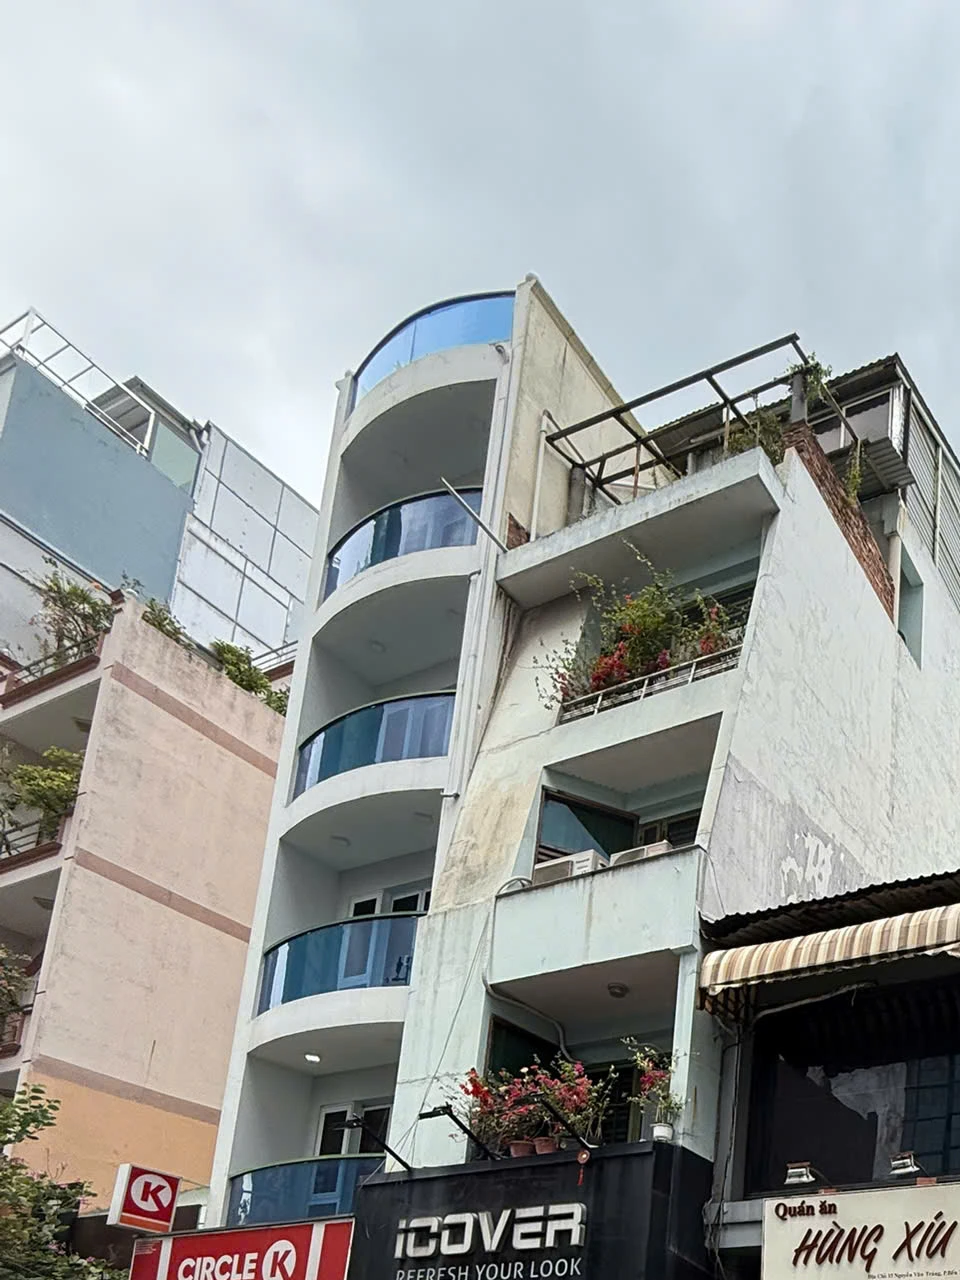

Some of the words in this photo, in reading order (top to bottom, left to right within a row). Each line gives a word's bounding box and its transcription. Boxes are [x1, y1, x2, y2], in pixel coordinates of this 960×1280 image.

[139, 1178, 168, 1212] K
[774, 1200, 815, 1221] Quán
[819, 1200, 838, 1217] ăn
[792, 1220, 885, 1273] HÙNG
[892, 1211, 959, 1262] XÍU
[529, 1257, 583, 1279] LOOK
